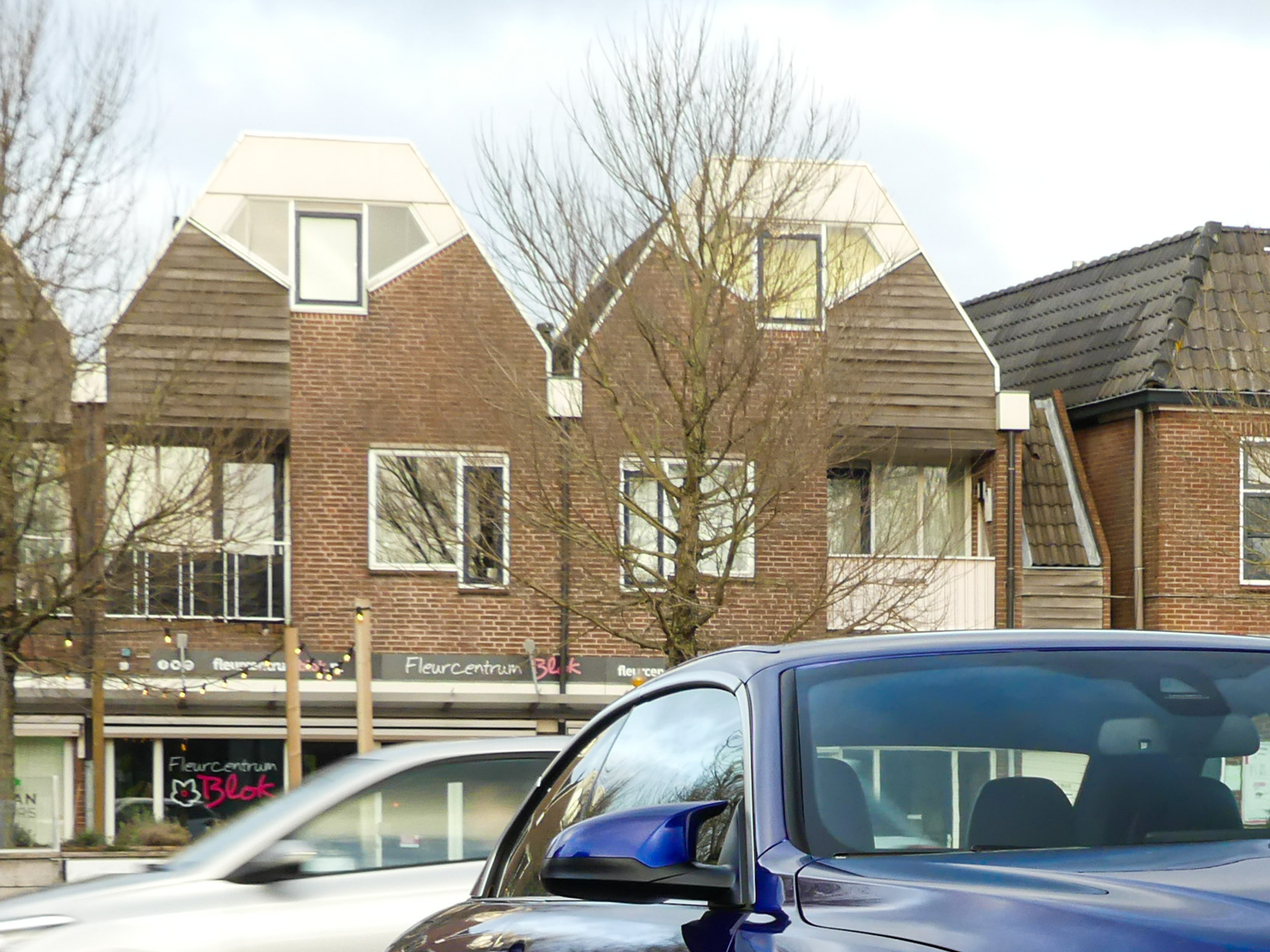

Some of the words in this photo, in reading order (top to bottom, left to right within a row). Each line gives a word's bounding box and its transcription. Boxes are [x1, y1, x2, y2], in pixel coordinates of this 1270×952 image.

[405, 656, 523, 676] Fleurcentrum
[534, 656, 582, 680] Blk
[168, 755, 278, 773] Fleurcentrum
[196, 773, 278, 809] Blok
